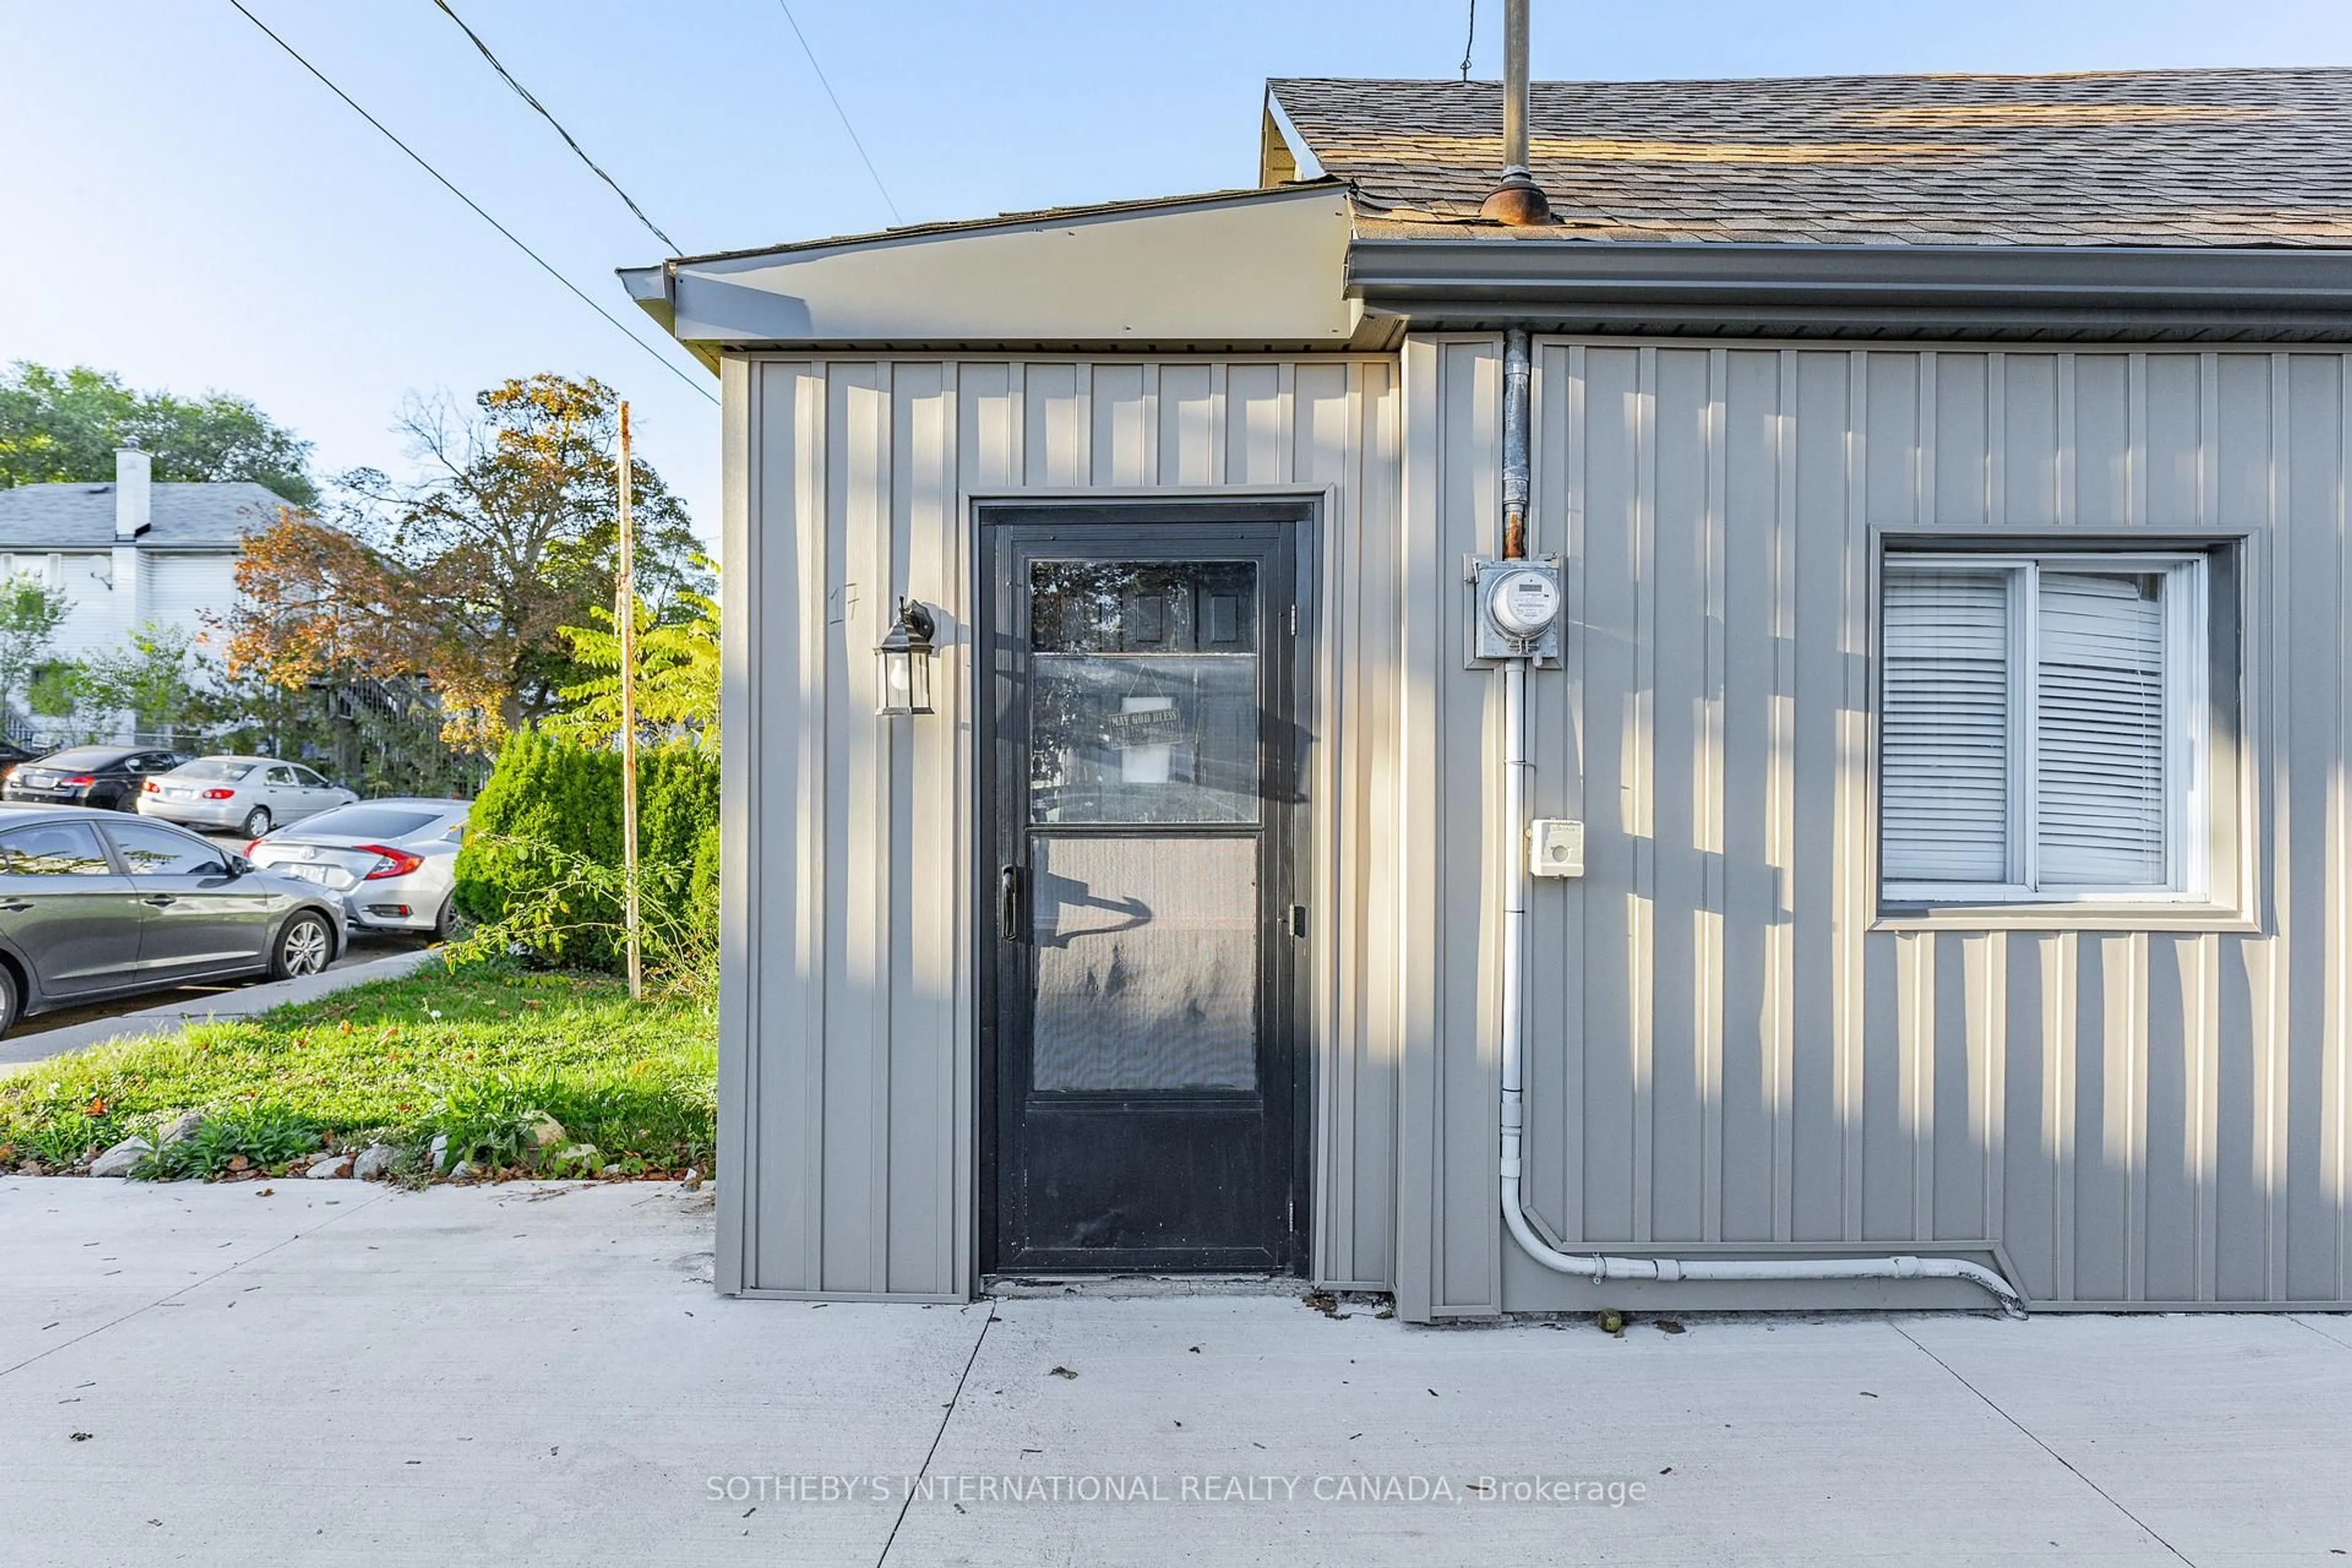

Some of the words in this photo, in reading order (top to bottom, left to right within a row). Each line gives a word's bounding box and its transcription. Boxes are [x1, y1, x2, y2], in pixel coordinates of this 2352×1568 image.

[1112, 715, 1128, 727] MAY
[1132, 714, 1150, 725] GOD
[1153, 712, 1177, 722] BLESS
